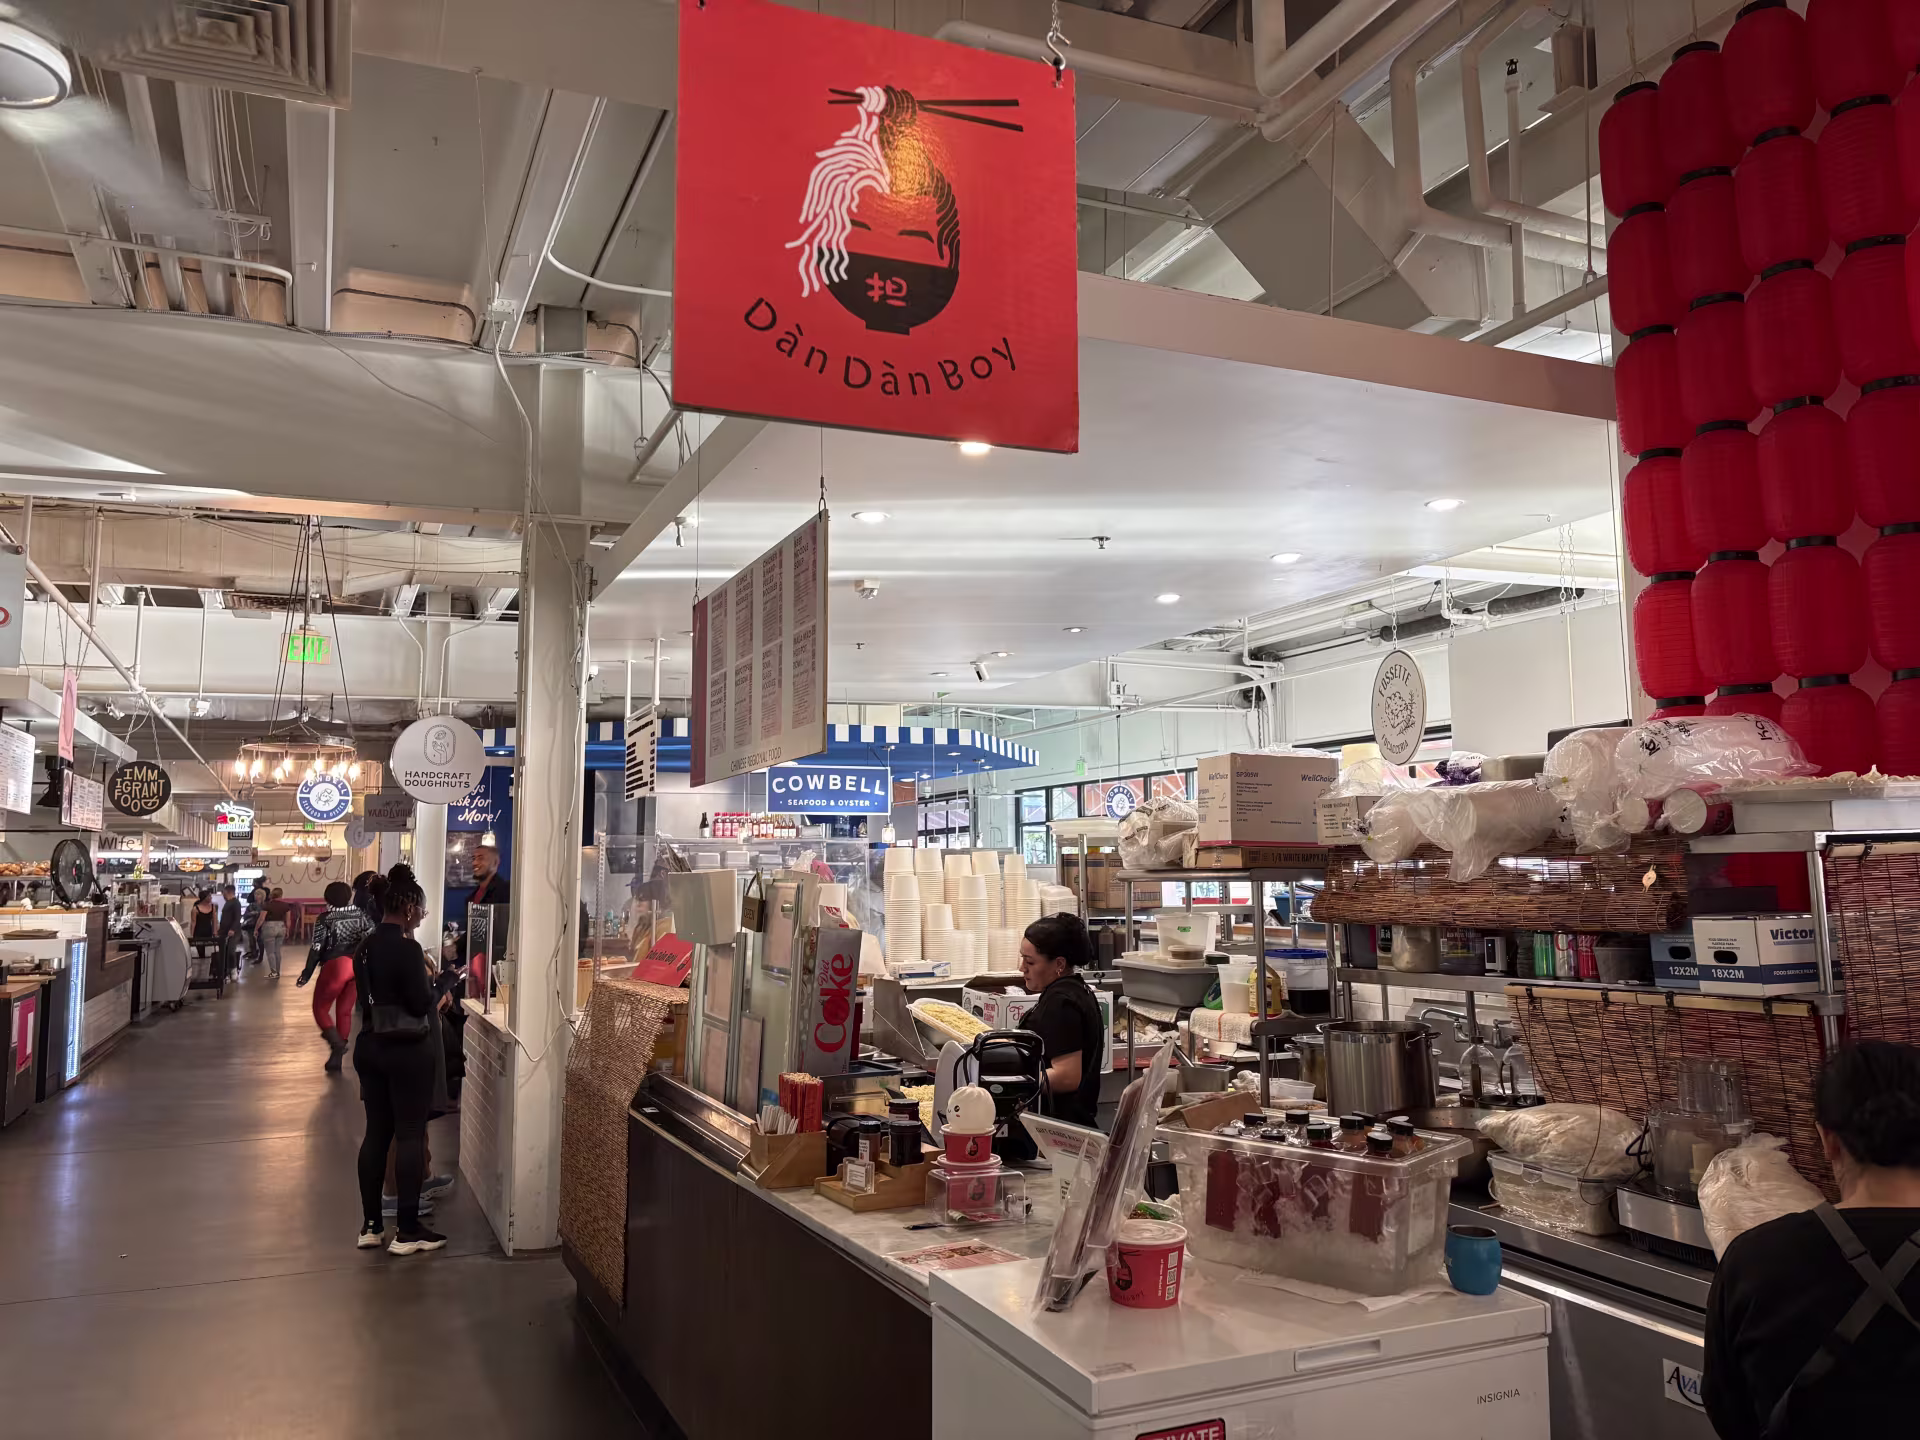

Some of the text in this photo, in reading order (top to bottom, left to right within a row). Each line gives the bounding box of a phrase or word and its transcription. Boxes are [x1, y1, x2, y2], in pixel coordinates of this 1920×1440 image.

[744, 297, 828, 375] Dàn
[843, 355, 931, 396] Dàn
[289, 636, 325, 662] EXIT
[1379, 664, 1411, 697] FOSSETTE
[731, 756, 747, 772] CHINESE
[769, 747, 782, 762] FOOD
[124, 766, 158, 781] IMM
[404, 771, 472, 780] HANDCRAFT
[1301, 774, 1337, 782] WellChoice
[115, 778, 165, 797] IGRANT
[302, 775, 348, 795] COWBELL
[404, 780, 470, 788] DOUGHNUTS
[772, 774, 885, 795] COWBELL
[1107, 786, 1134, 801] COWBELL
[302, 800, 322, 819] SEAFOOD
[328, 802, 346, 819] OYSTER
[472, 796, 492, 808] for
[838, 799, 870, 807] OYSTER
[458, 809, 502, 825] More!
[744, 908, 755, 921] OPEN
[818, 960, 830, 987] Diet
[1669, 966, 1699, 976] 12X2M
[1711, 968, 1745, 979] 18X2M
[814, 953, 854, 1053] Coke
[1666, 1366, 1702, 1399] AVA
[1477, 1388, 1520, 1404] INSIGNIA
